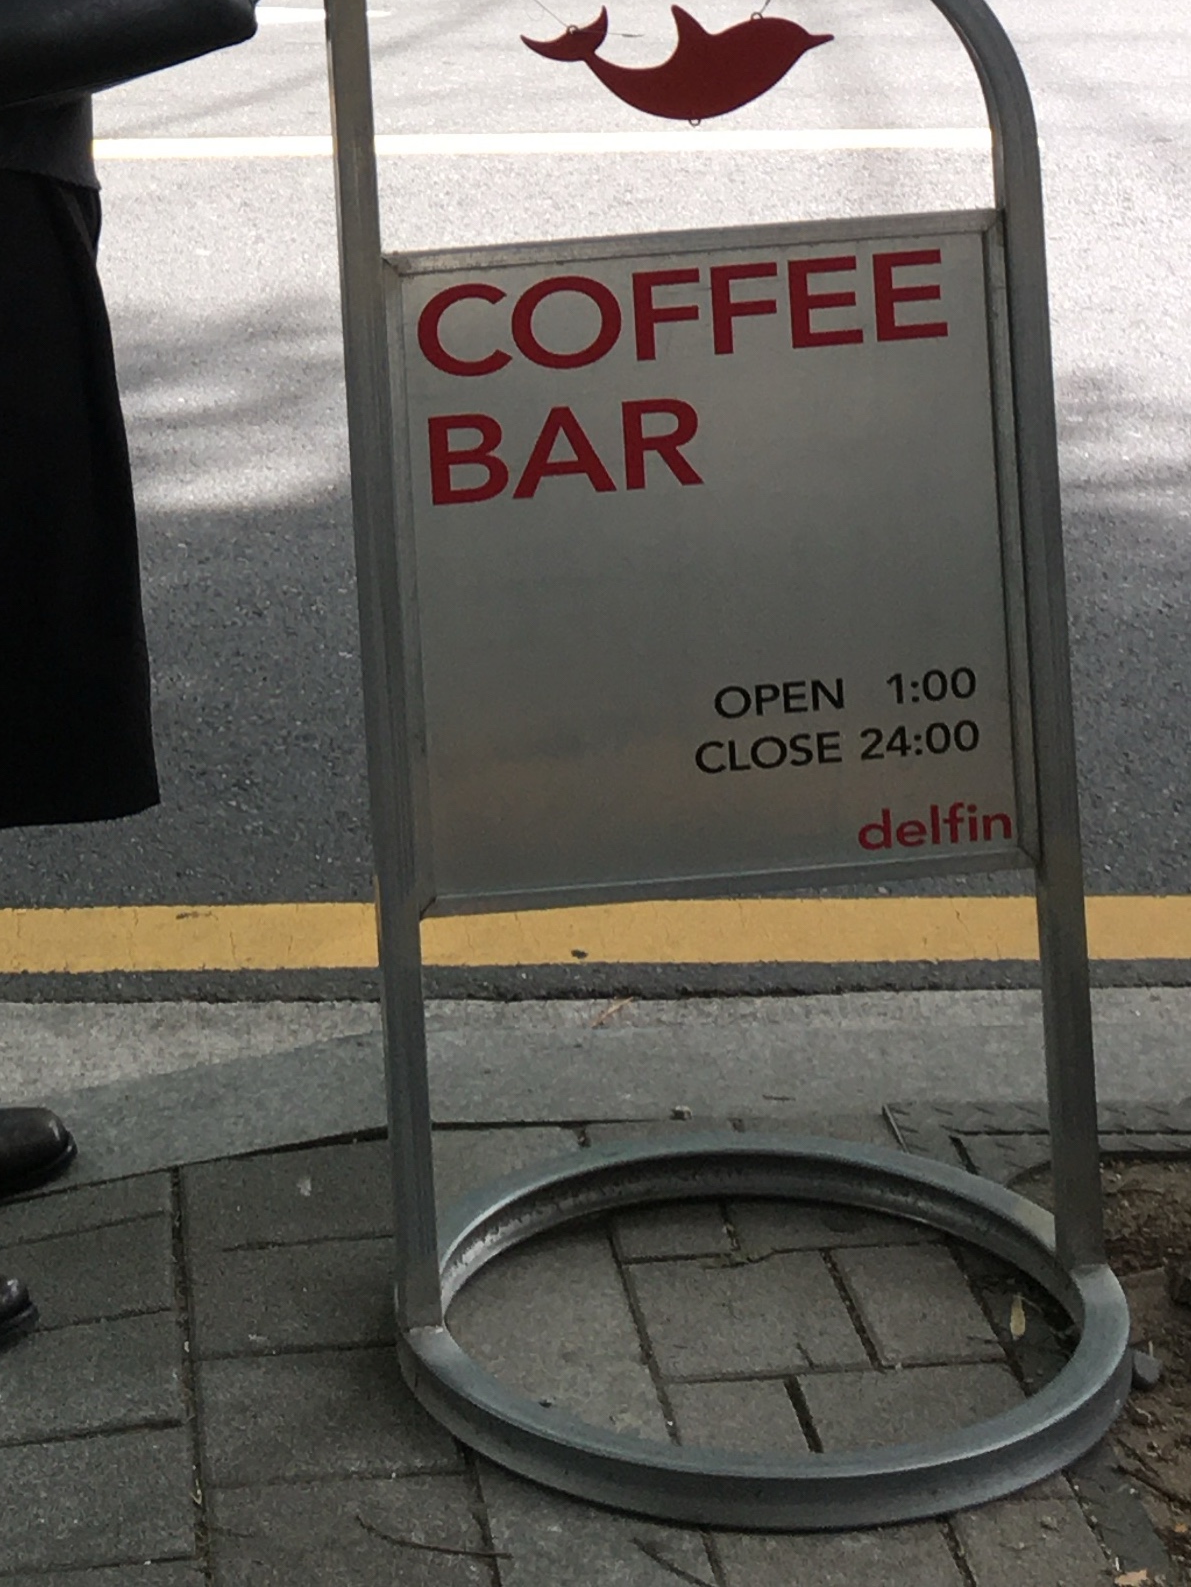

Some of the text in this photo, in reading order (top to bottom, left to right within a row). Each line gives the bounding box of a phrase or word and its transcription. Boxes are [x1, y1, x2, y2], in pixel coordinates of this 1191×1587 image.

[416, 247, 949, 377] COFFEE
[427, 397, 704, 506] BAR
[714, 666, 977, 720] OPEN 1:00
[694, 719, 980, 775] CLOSE 24:00
[857, 800, 1013, 851] delfin
